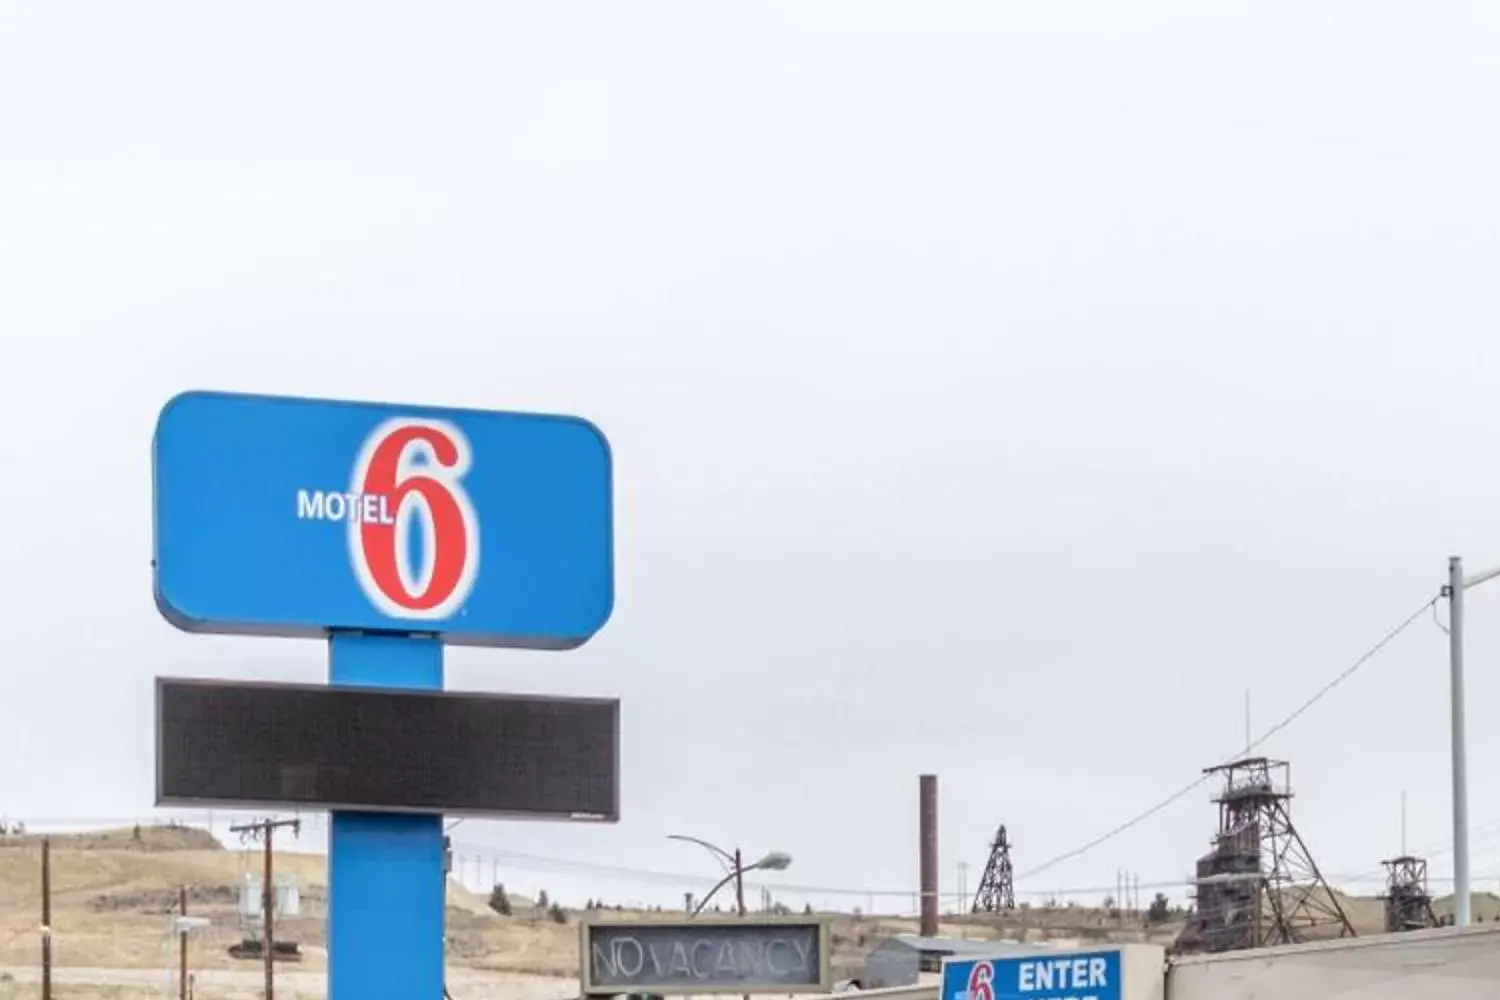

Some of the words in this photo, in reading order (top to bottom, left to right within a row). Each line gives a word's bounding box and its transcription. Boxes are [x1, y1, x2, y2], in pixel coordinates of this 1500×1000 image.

[297, 489, 395, 524] MOTEL
[348, 416, 480, 619] 6
[592, 936, 643, 978] NO
[648, 932, 812, 979] VACANCY
[1019, 957, 1107, 992] ENTER
